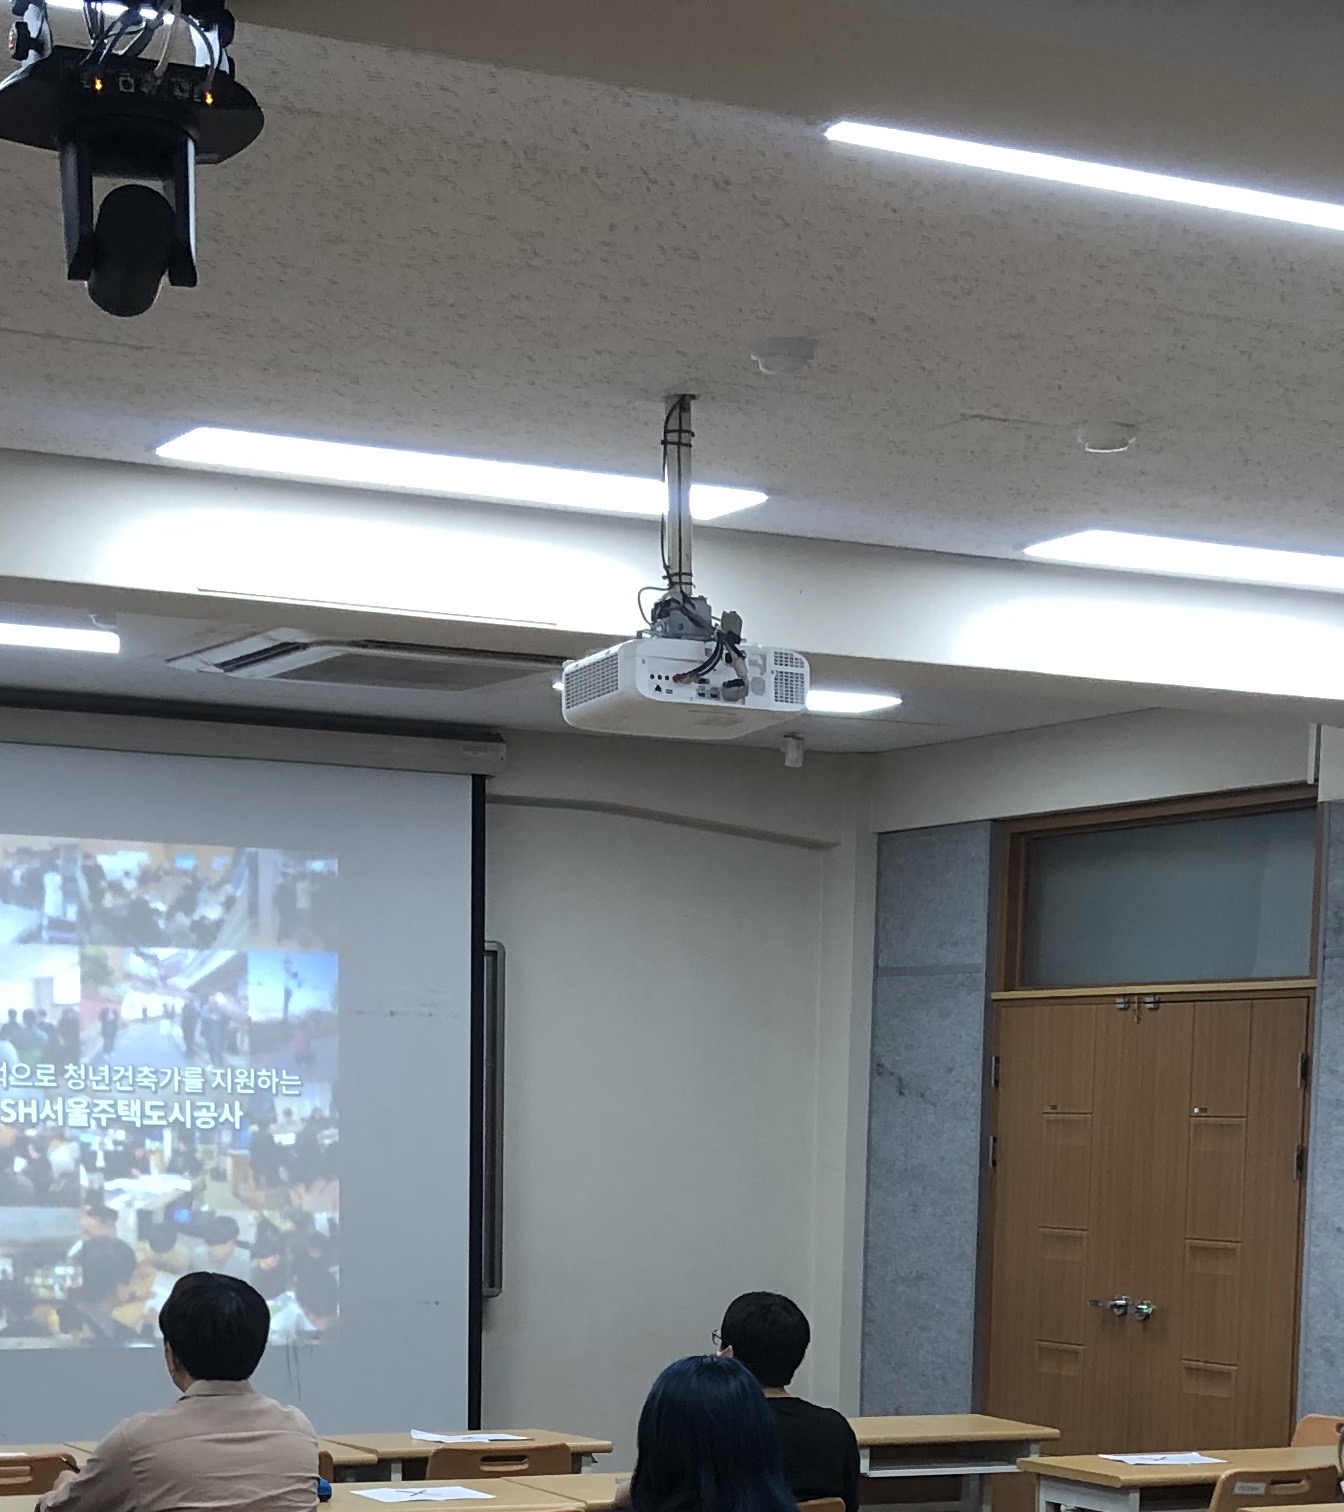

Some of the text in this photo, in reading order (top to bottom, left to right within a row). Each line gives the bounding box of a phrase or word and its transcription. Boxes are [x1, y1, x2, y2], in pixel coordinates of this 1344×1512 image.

[63, 1062, 205, 1094] 청년건축가를
[211, 1066, 302, 1096] 지원하는
[0, 1097, 244, 1129] SH서울주택도시공사
